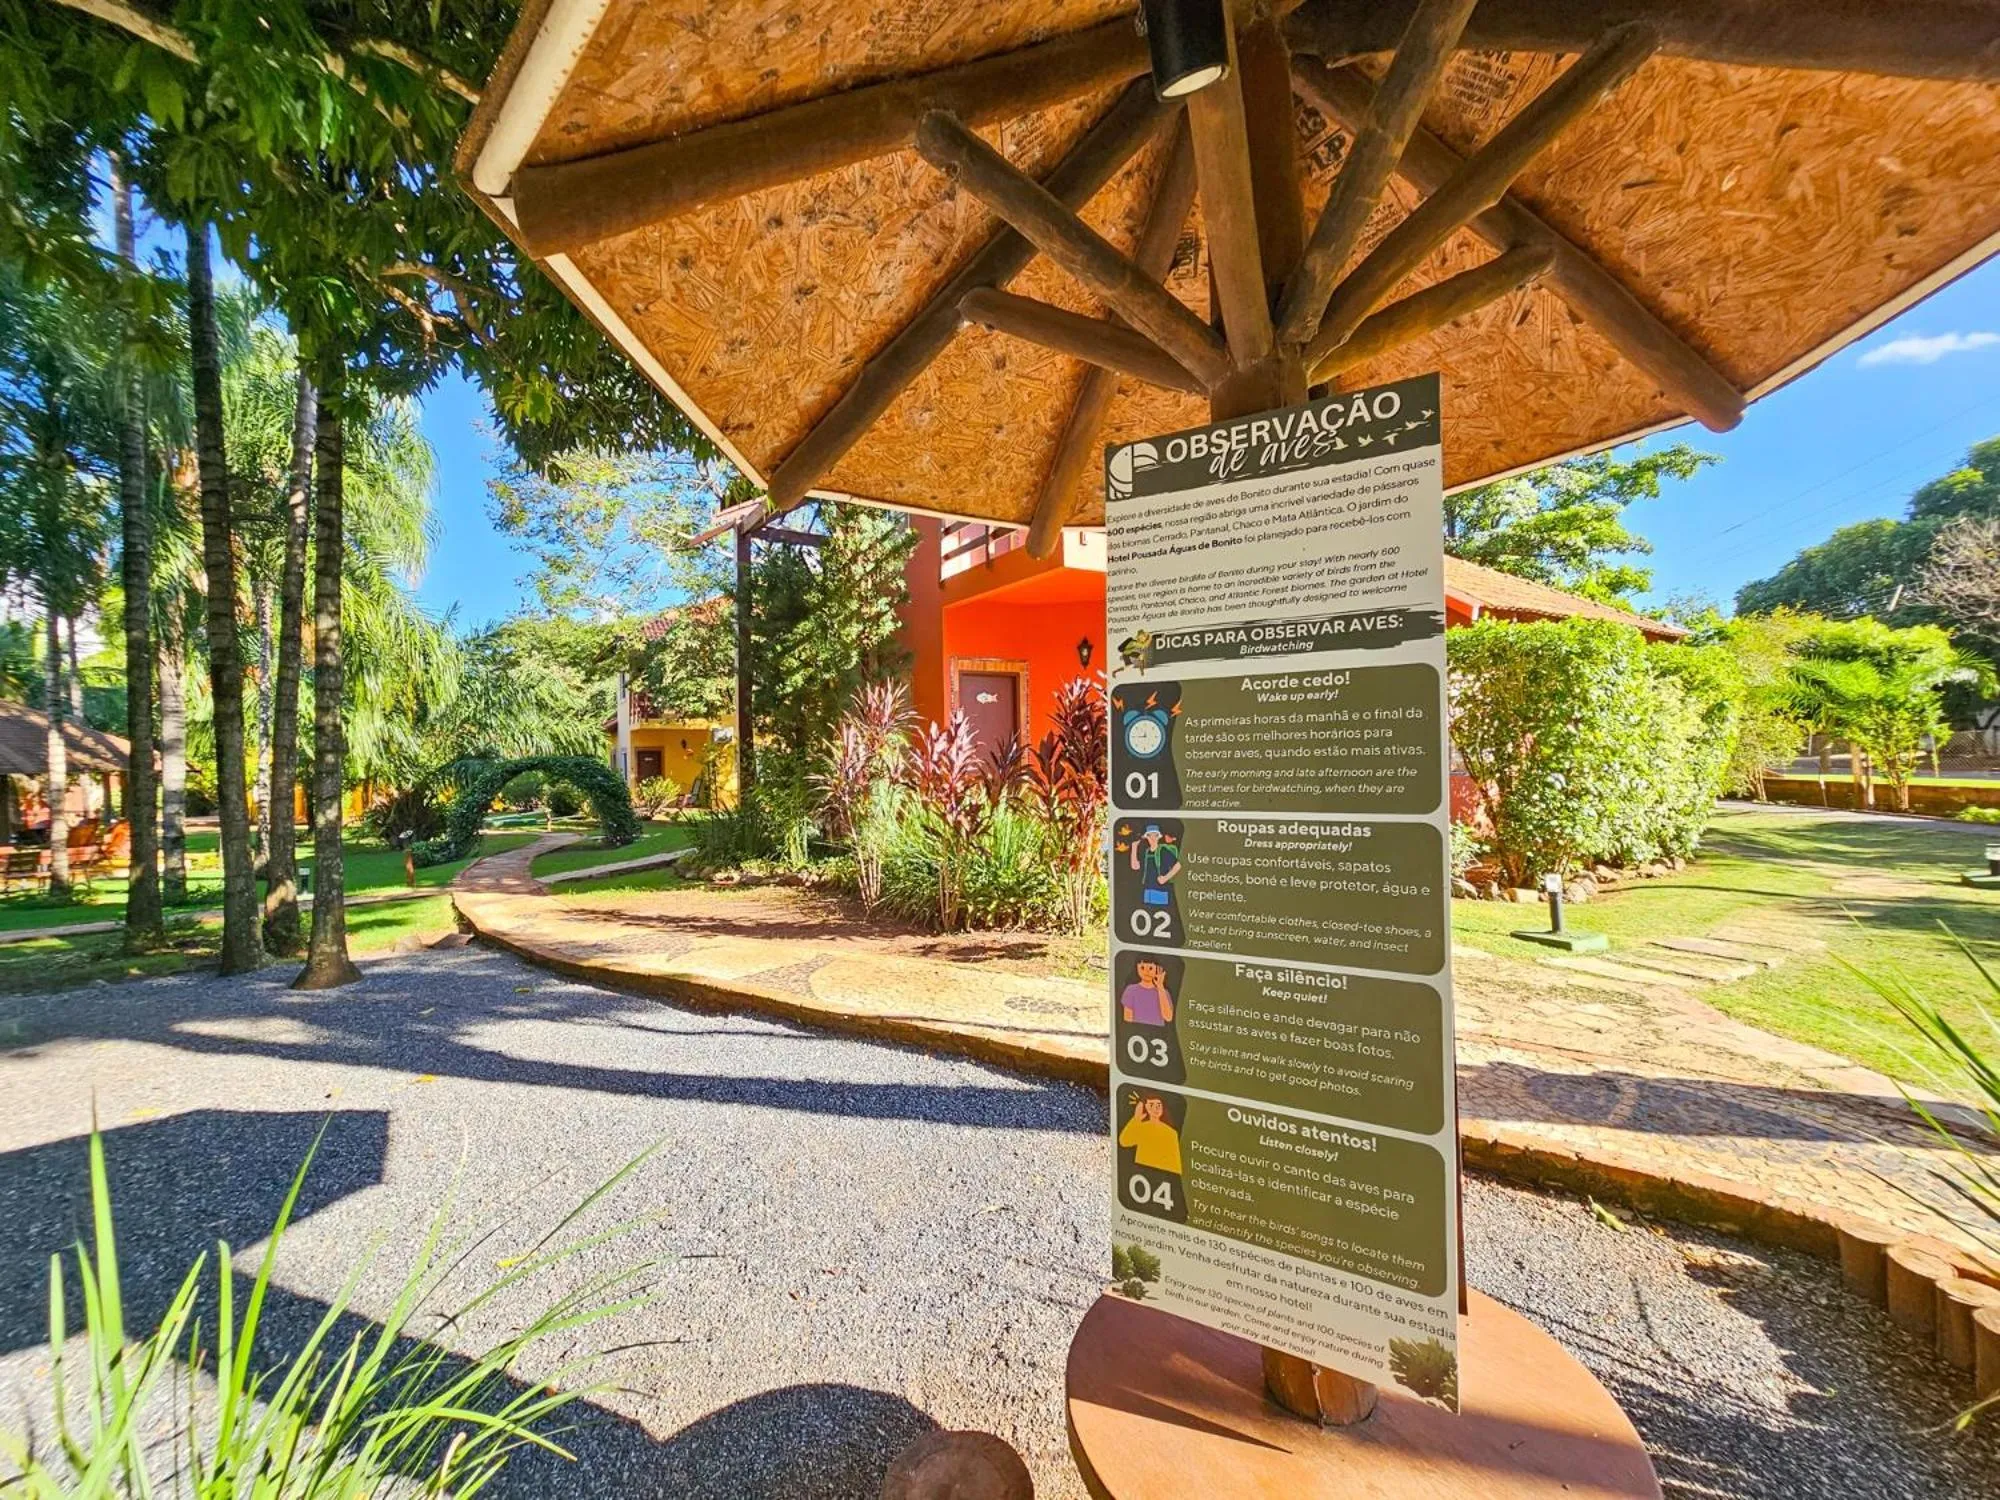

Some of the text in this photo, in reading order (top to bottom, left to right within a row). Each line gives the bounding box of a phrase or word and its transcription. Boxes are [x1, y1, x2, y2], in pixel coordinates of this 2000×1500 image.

[1166, 391, 1401, 463] OBSERVAÇÃO
[1209, 430, 1333, 478] de aves
[1240, 459, 1435, 500] Bonito durante sua estadia! Com quase
[1189, 478, 1418, 523] região abriga uma incrível variedade de pássaros
[1232, 520, 1262, 530] Chaco
[1272, 514, 1296, 523] Mata
[1347, 502, 1356, 511] O
[1357, 498, 1391, 512] jardim
[1394, 495, 1408, 504] do
[1107, 512, 1410, 563] Hotel Pousada Águas de Bonito foi planejado para recebê-los com
[1155, 614, 1403, 650] DICAS PARA OBSERVAR AVES:
[1239, 640, 1313, 654] Birdwatching
[1240, 671, 1350, 690] Acorde cedo!
[1257, 689, 1338, 702] Wake up early!
[1185, 707, 1422, 729] As primeiras horas da manhã e o final da
[1184, 728, 1392, 743] tarde são os melhores horários para
[1185, 744, 1426, 760] observar aves, quando estão mais ativas.
[1125, 771, 1159, 799] 01
[1217, 820, 1371, 838] Roupas adequadas
[1244, 839, 1352, 853] Dress appropriately!
[1187, 852, 1390, 874] Use roupas confortáveis, sapatos
[1187, 870, 1430, 896] fechados, boné e leve protetor, água e
[1187, 890, 1246, 902] repelente.
[1130, 908, 1171, 939] 02
[1235, 963, 1347, 989] Faça silêncio!
[1262, 986, 1327, 1004] Keep quiet!
[1188, 1000, 1420, 1043] Faça silêncio e ande devagar para não
[1188, 1019, 1394, 1058] assustar as aves e fazer boas fotos.
[1127, 1033, 1168, 1068] 03
[1189, 1056, 1361, 1095] the birds and to get good photos.
[1227, 1107, 1376, 1152] Ouvidos atentos!
[1259, 1135, 1338, 1163] Listen closely!
[1191, 1141, 1413, 1204] Procure ouvir o canto das aves para
[1128, 1171, 1174, 1213] 04
[1191, 1159, 1399, 1221] localizá-las e identificar a espécie
[1191, 1178, 1254, 1203] observada.
[1193, 1199, 1208, 1214] Try
[1210, 1204, 1221, 1215] to
[1223, 1207, 1246, 1222] hear
[1249, 1215, 1265, 1227] the
[1300, 1230, 1334, 1247] songs
[1336, 1239, 1348, 1250] to
[1351, 1241, 1391, 1262] locate
[1393, 1254, 1424, 1271] them
[1178, 1245, 1455, 1341] Venha desfrutar da natureza durante sua estadia
[1226, 1279, 1312, 1313] em nosso hotel!
[1295, 1266, 1447, 1319] plantas e 100 de aves em
